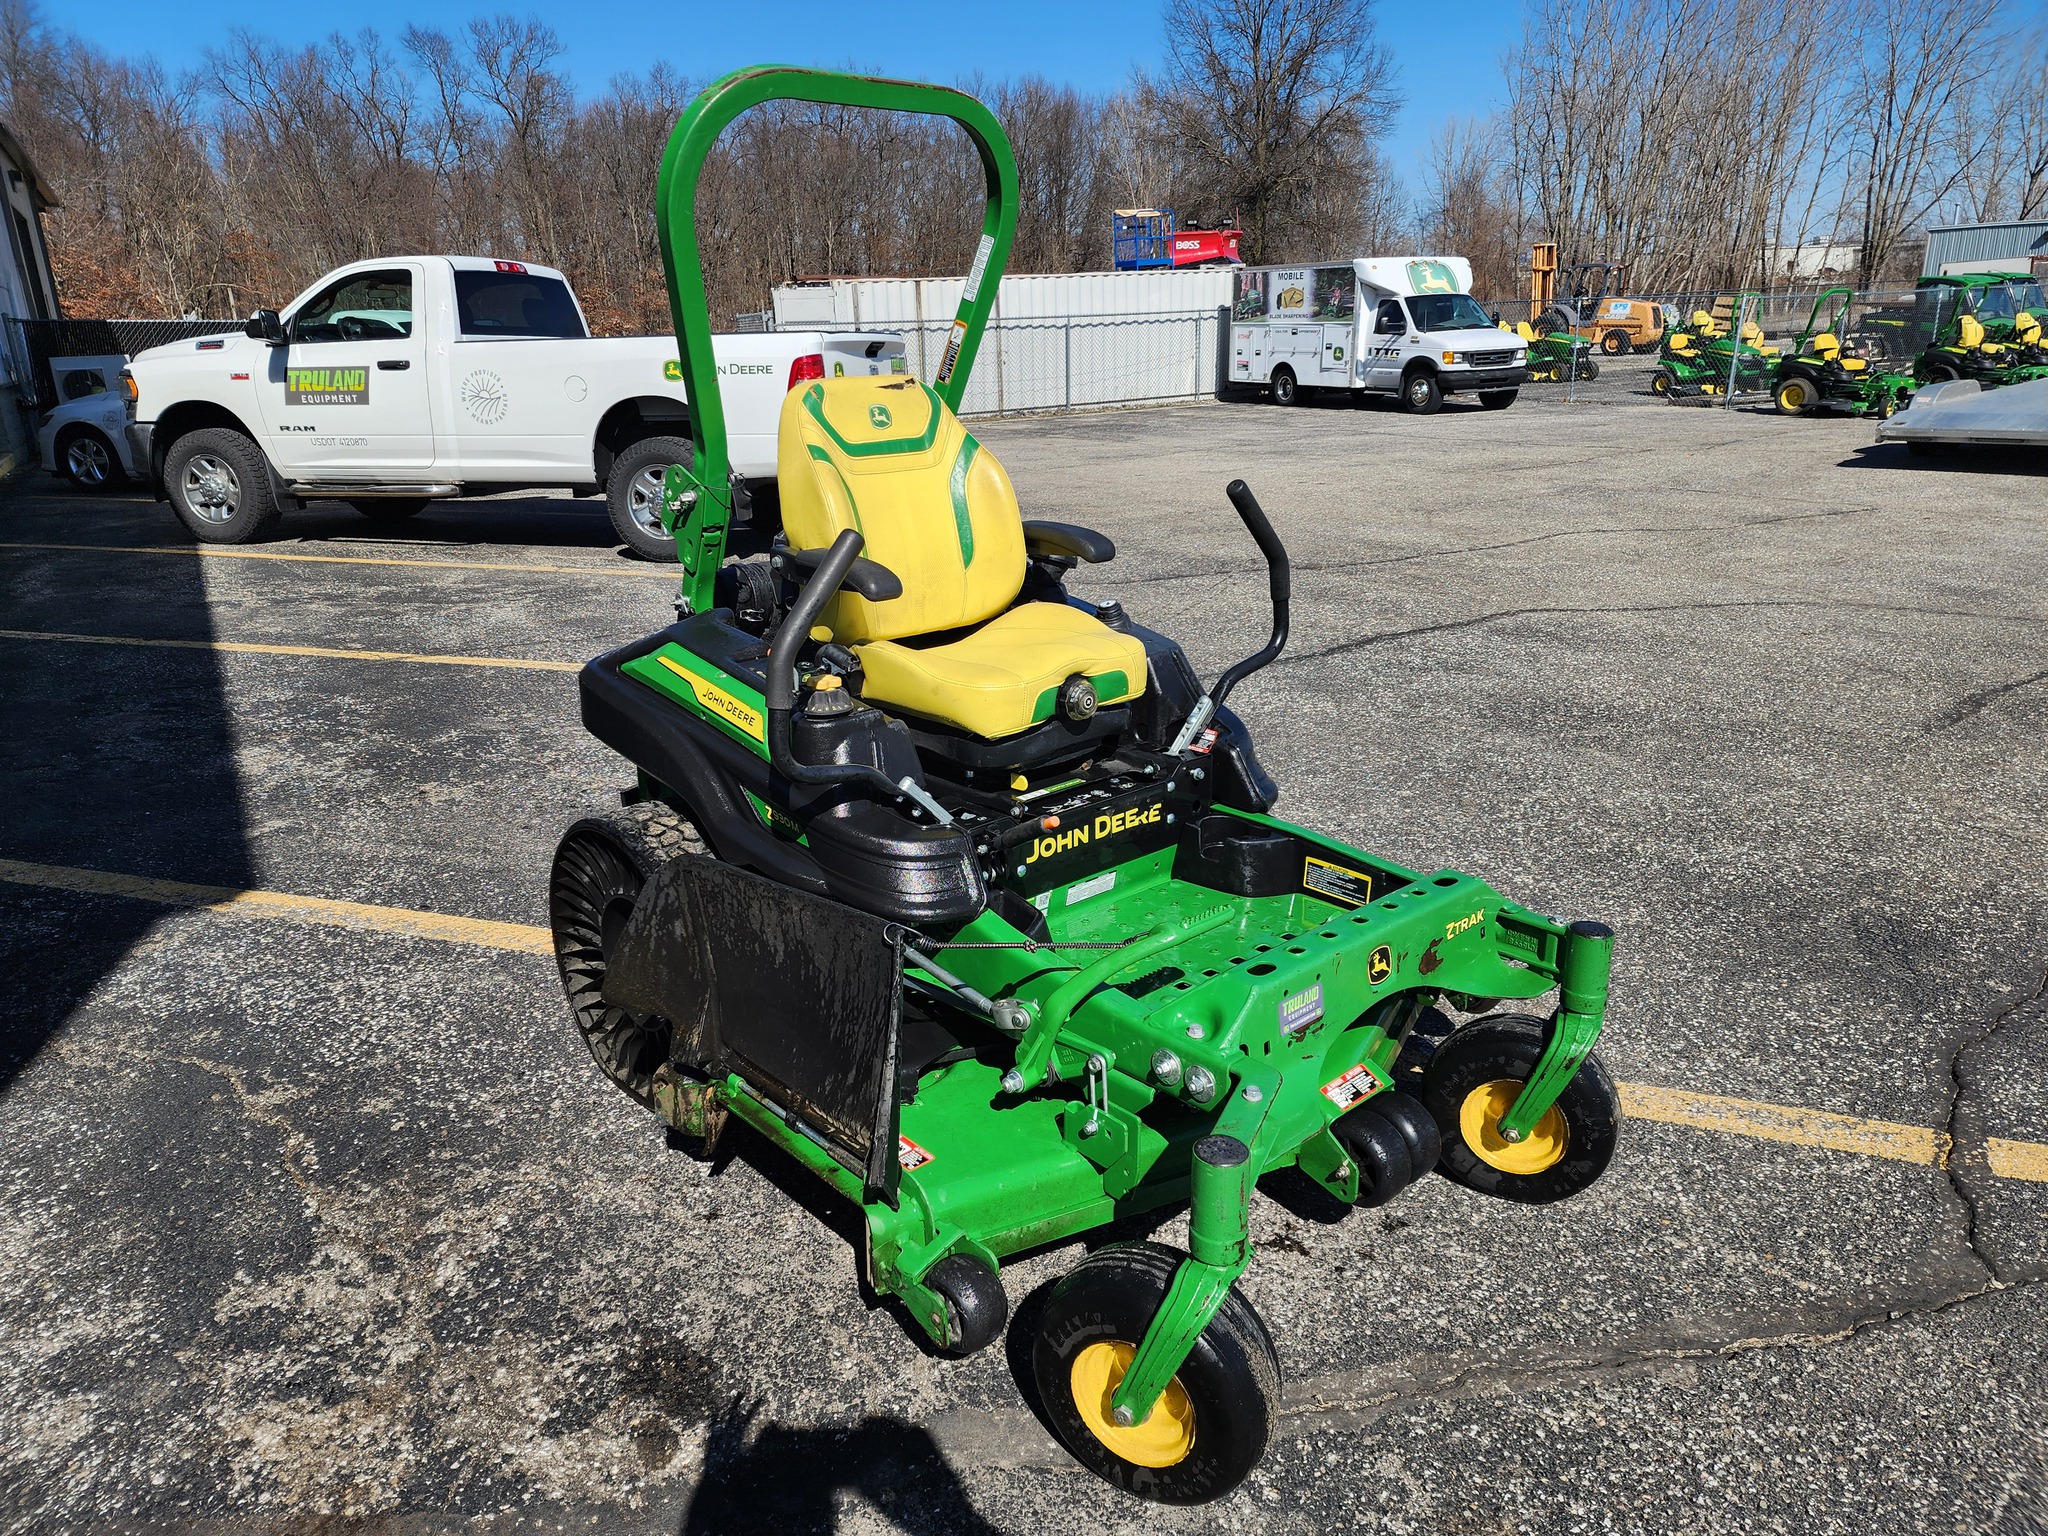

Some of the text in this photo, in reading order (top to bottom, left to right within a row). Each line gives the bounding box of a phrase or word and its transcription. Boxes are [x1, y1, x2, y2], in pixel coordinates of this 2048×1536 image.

[1176, 241, 1200, 250] BOSS
[1278, 272, 1304, 280] MOBILE
[1374, 348, 1401, 358] TTG
[470, 369, 501, 383] PROVIDER
[730, 364, 773, 375] DEERE
[288, 370, 365, 391] TRULAND
[301, 395, 357, 404] EQUIPMENT
[471, 393, 508, 425] MEANS PARTNER
[310, 437, 368, 446] USDOT 4120870
[703, 688, 756, 727] JOHN DEERE
[765, 805, 800, 834] Z930M
[1026, 803, 1162, 864] JOHN DEERE
[1446, 908, 1485, 940] ZTRAK
[1283, 986, 1319, 1017] TRULAND
[1289, 1003, 1316, 1021] EQUIPMENT
